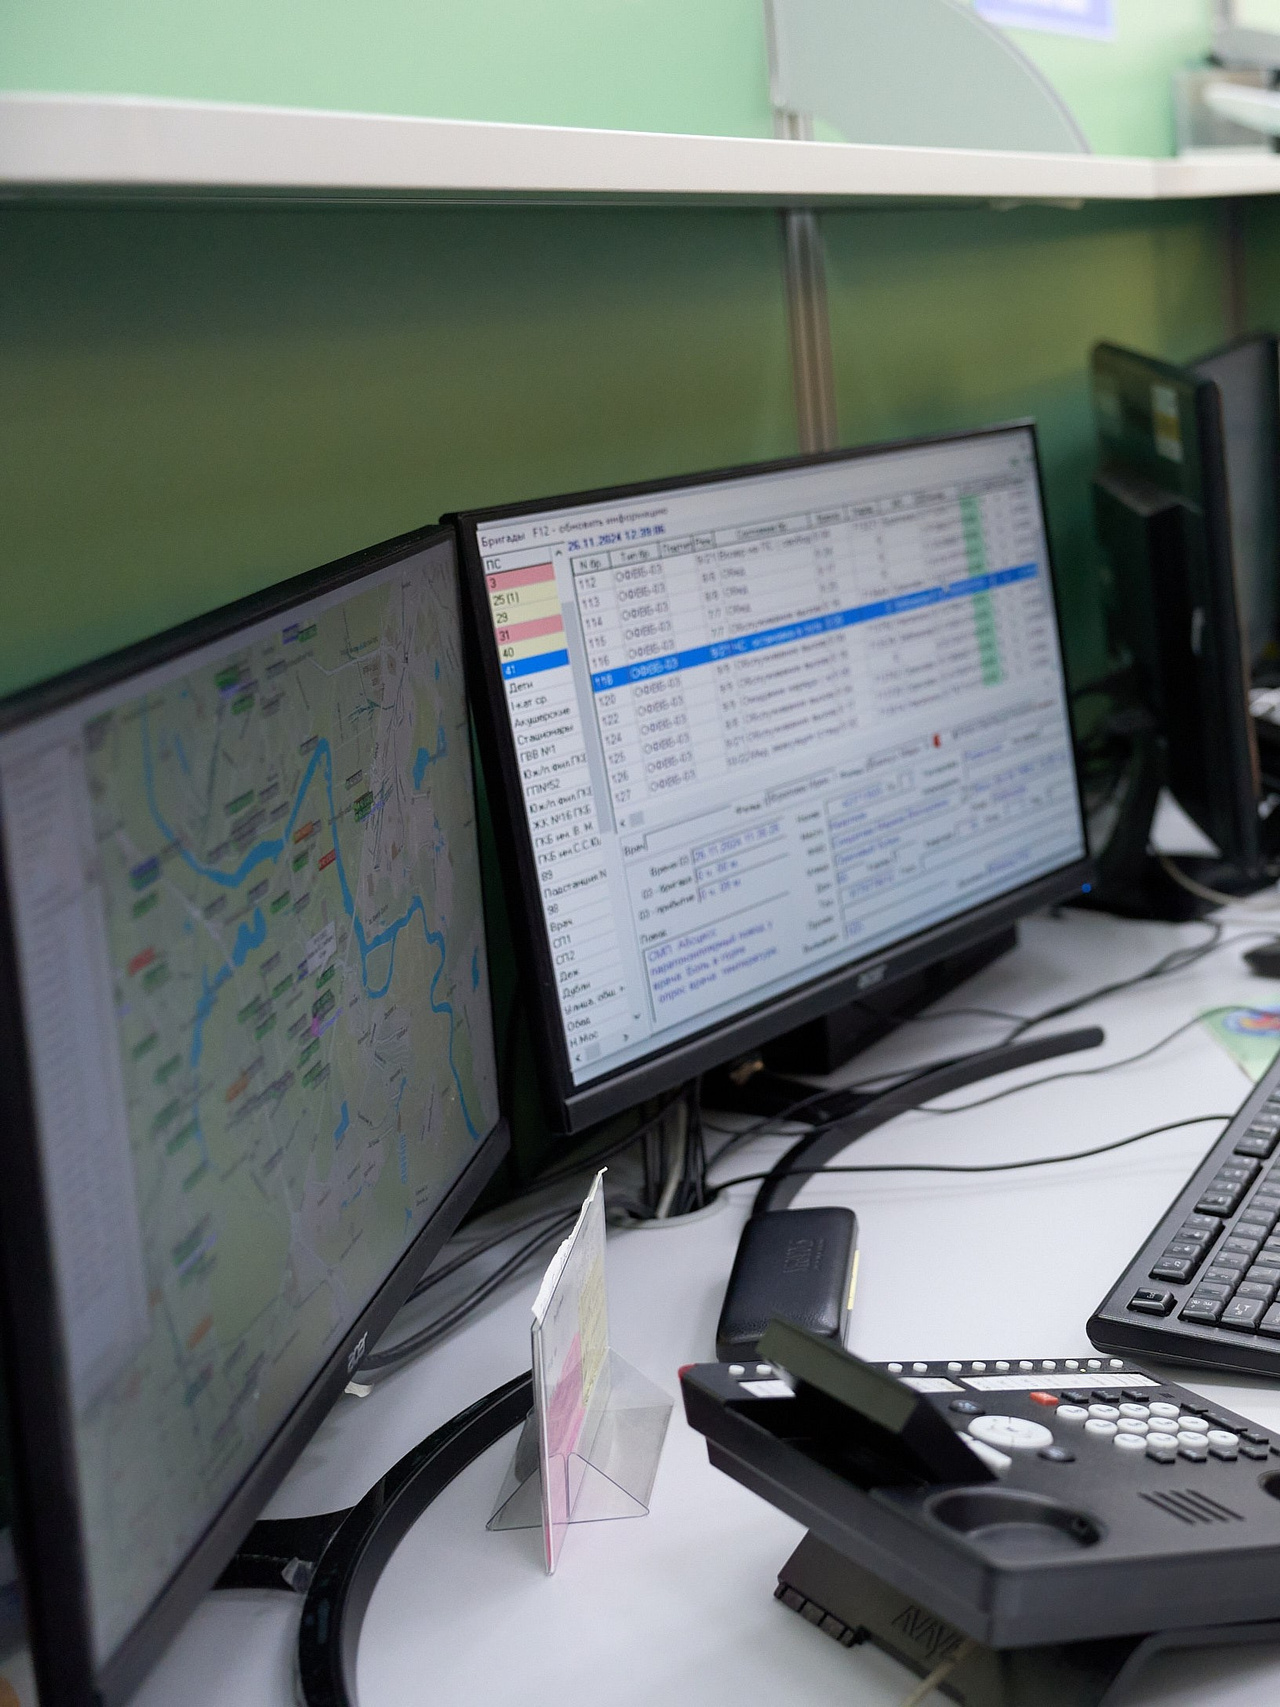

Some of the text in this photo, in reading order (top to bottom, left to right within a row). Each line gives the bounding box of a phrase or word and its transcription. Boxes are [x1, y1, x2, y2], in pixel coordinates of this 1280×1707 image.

[481, 529, 525, 549] Бригады
[532, 525, 549, 538] F12
[567, 531, 622, 552] 26.11.2024
[486, 558, 501, 571] ПС
[489, 577, 497, 588] 3
[492, 591, 519, 607] 25 (1)
[495, 611, 508, 624] 29
[498, 629, 510, 642] 31
[502, 646, 515, 659] 40
[504, 664, 516, 676] 41
[508, 677, 534, 694] Дети
[514, 704, 571, 730] Акушерские
[516, 721, 574, 747] Стационары
[520, 748, 539, 763] ГВВ
[535, 833, 553, 848] ГКБ
[537, 849, 557, 865] ГКБ
[540, 868, 553, 882] 89
[543, 870, 599, 899] Подстанция
[549, 915, 573, 933] Врач
[552, 933, 571, 949] СП1
[555, 949, 576, 966] СП2
[347, 1331, 368, 1374] acer
